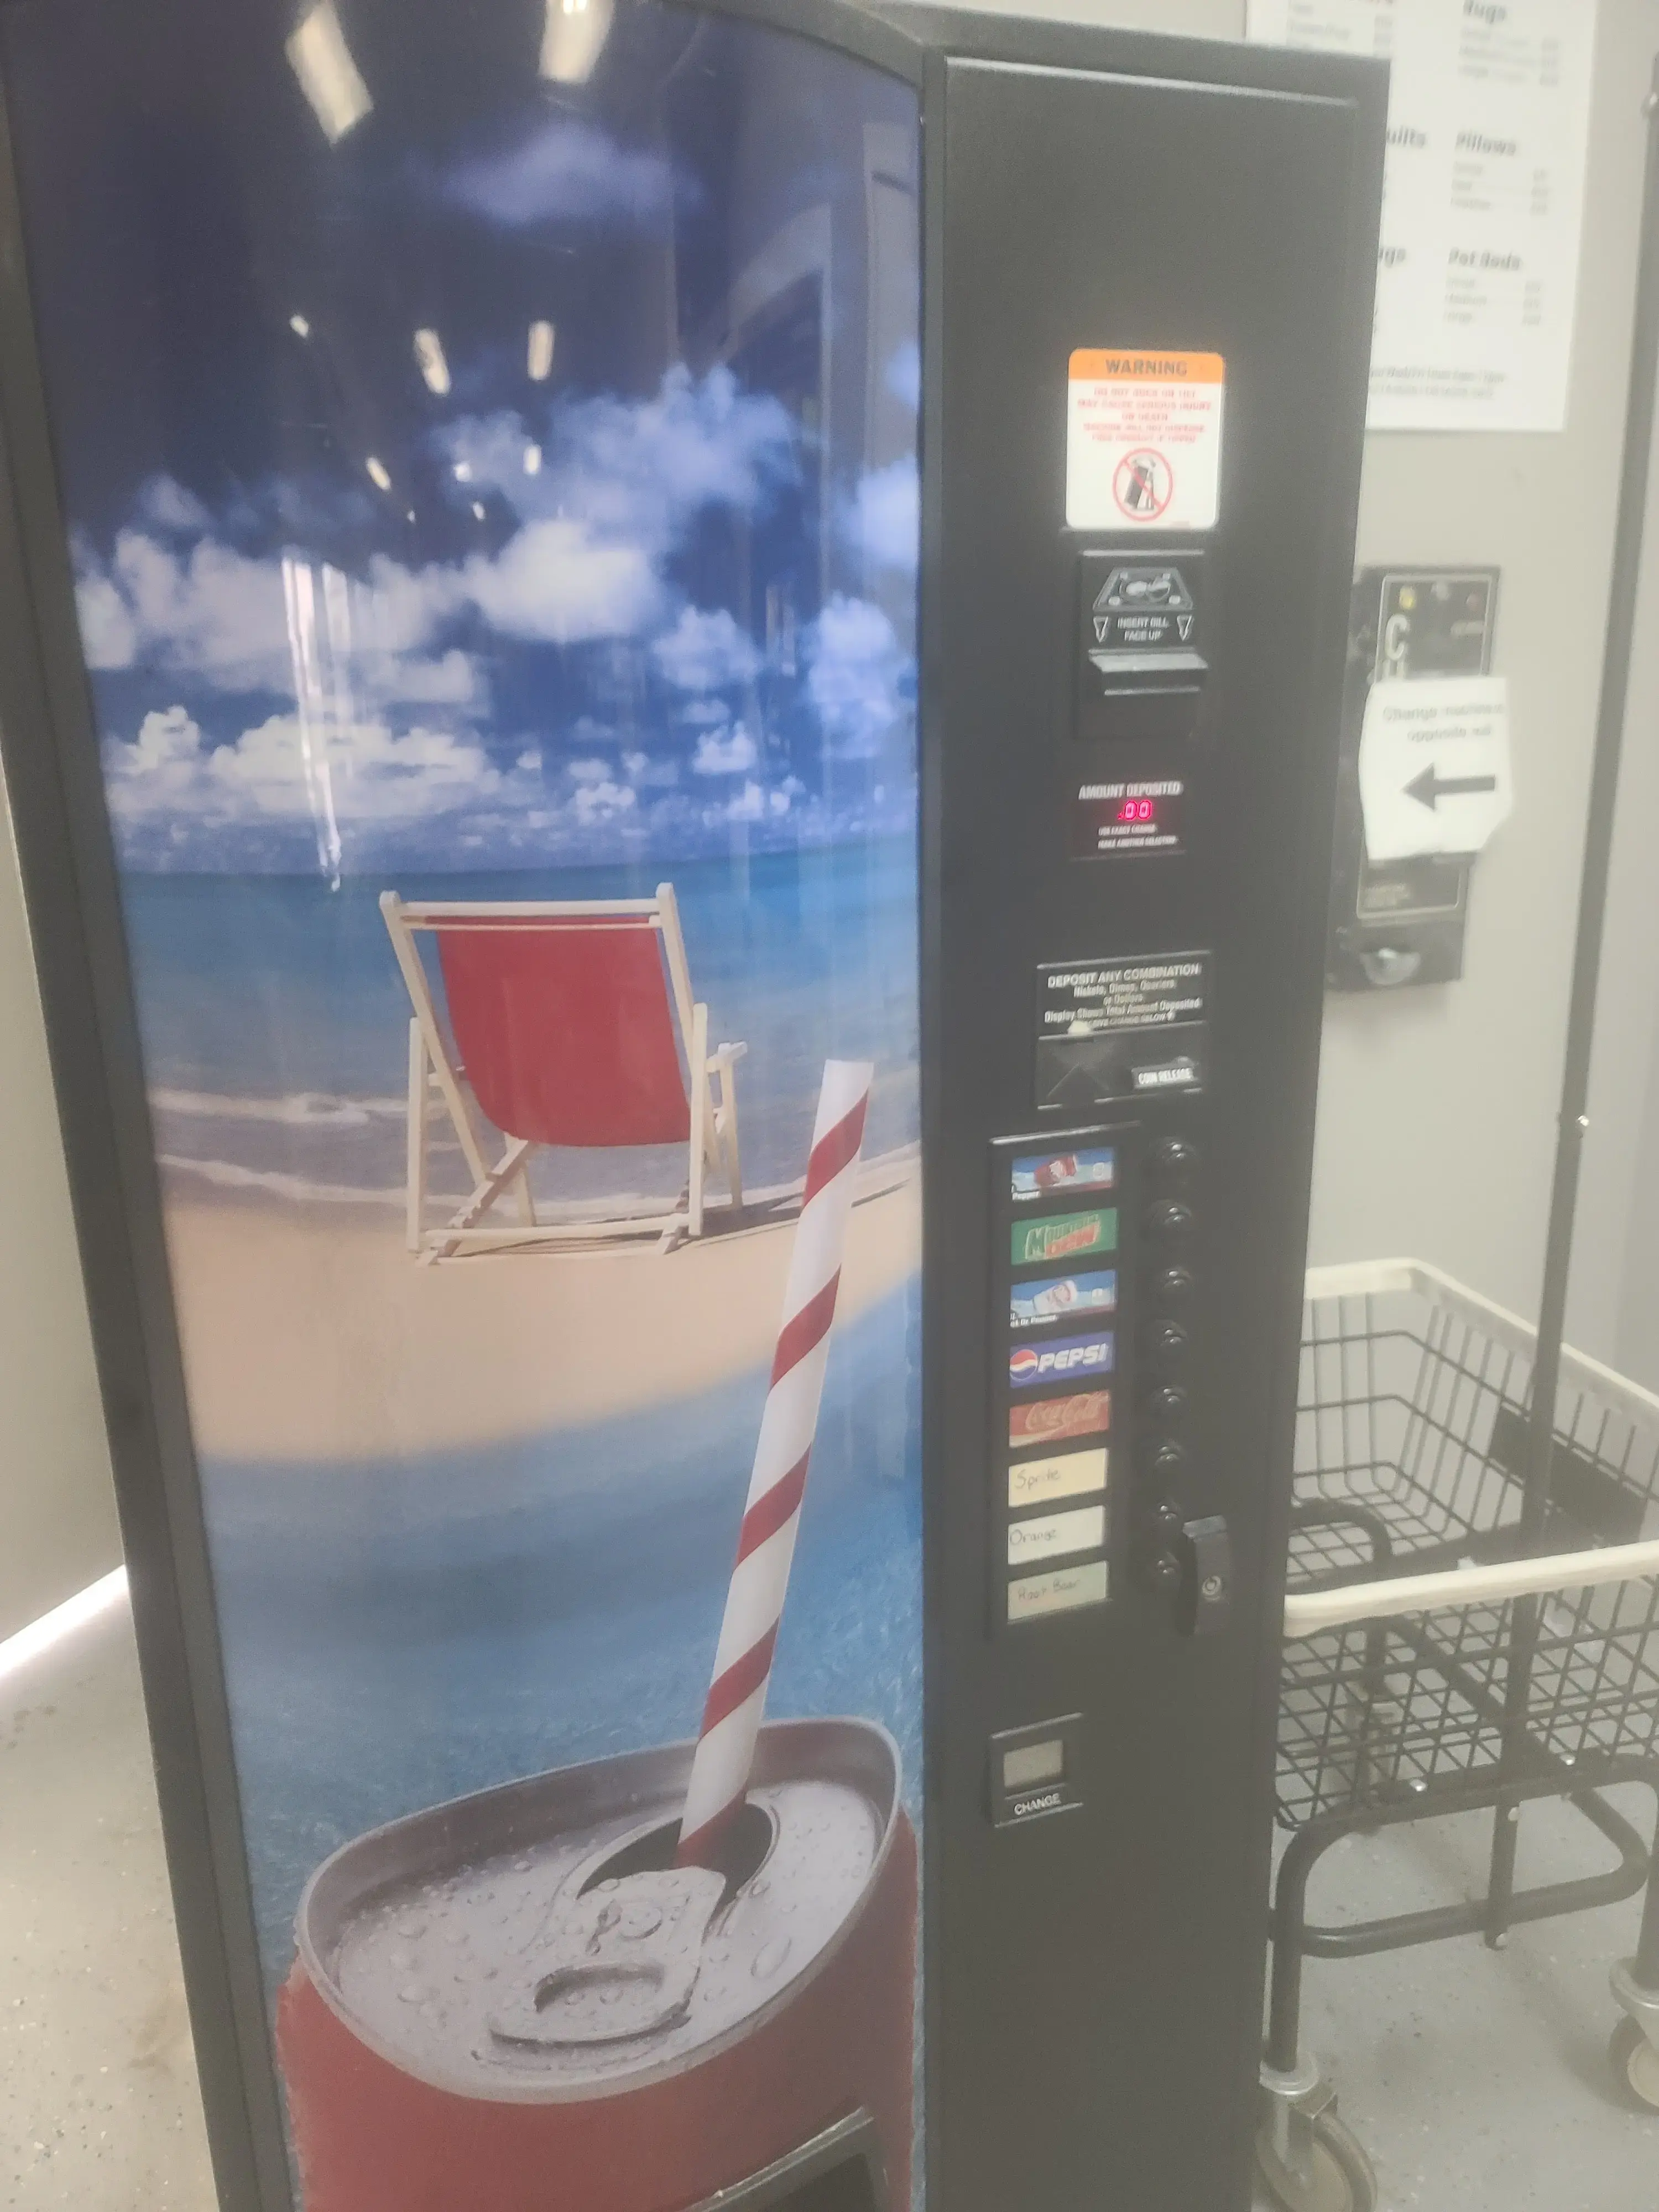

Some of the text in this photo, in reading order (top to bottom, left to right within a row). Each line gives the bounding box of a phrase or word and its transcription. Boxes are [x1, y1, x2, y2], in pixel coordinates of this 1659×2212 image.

[1385, 126, 1426, 148] uilts
[1105, 358, 1188, 377] WARNING
[1149, 630, 1162, 641] UP
[1078, 780, 1185, 800] AMOUNT DEPOSITED
[1047, 962, 1203, 989] DEPOSIT ANY COMBINATION
[1044, 1009, 1076, 1024] Display
[1012, 1191, 1041, 1200] Pepper
[1037, 1343, 1109, 1373] PEPSI
[1014, 1468, 1061, 1490] Sprite
[1009, 1528, 1057, 1546] Orange
[1017, 1577, 1081, 1603] Root Beer
[1014, 1792, 1062, 1815] CHANGE
